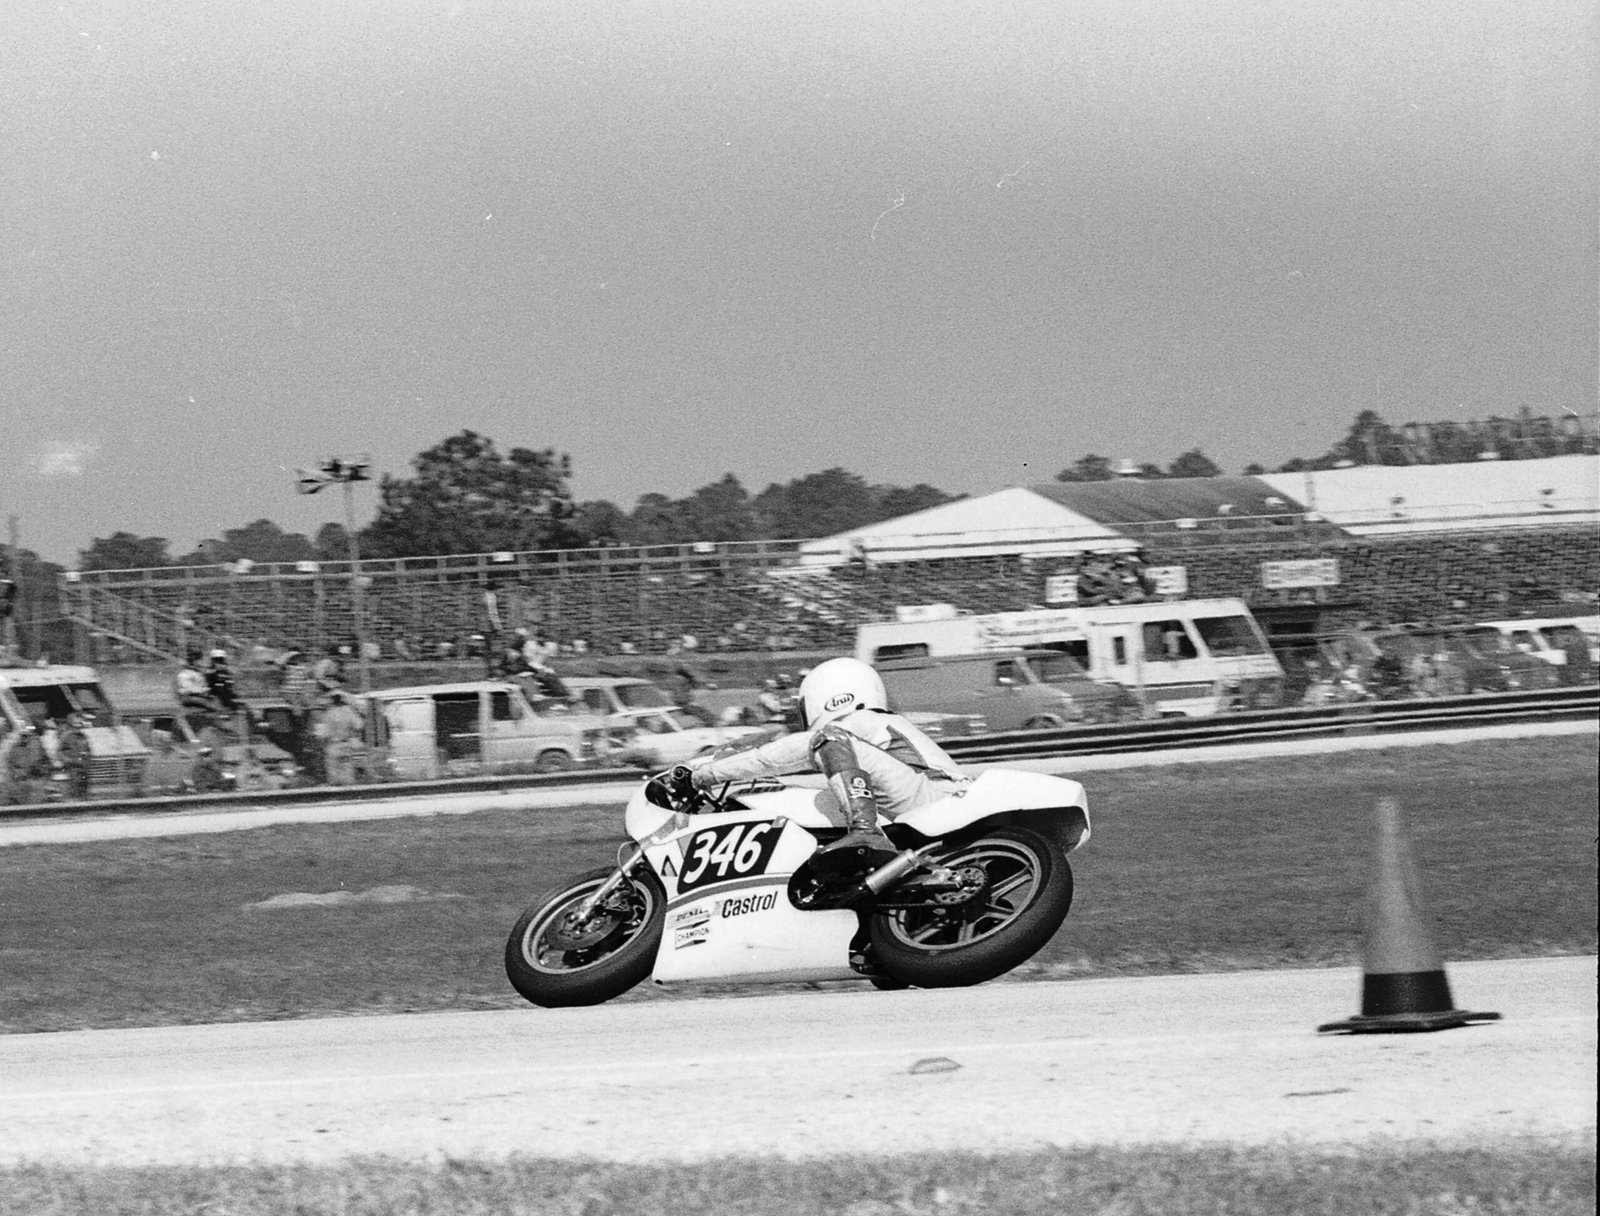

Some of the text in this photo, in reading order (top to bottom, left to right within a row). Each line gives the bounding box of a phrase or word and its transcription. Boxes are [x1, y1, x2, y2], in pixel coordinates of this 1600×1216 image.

[829, 693, 851, 707] Arai
[682, 822, 772, 884] 346
[721, 890, 778, 918] Castrol
